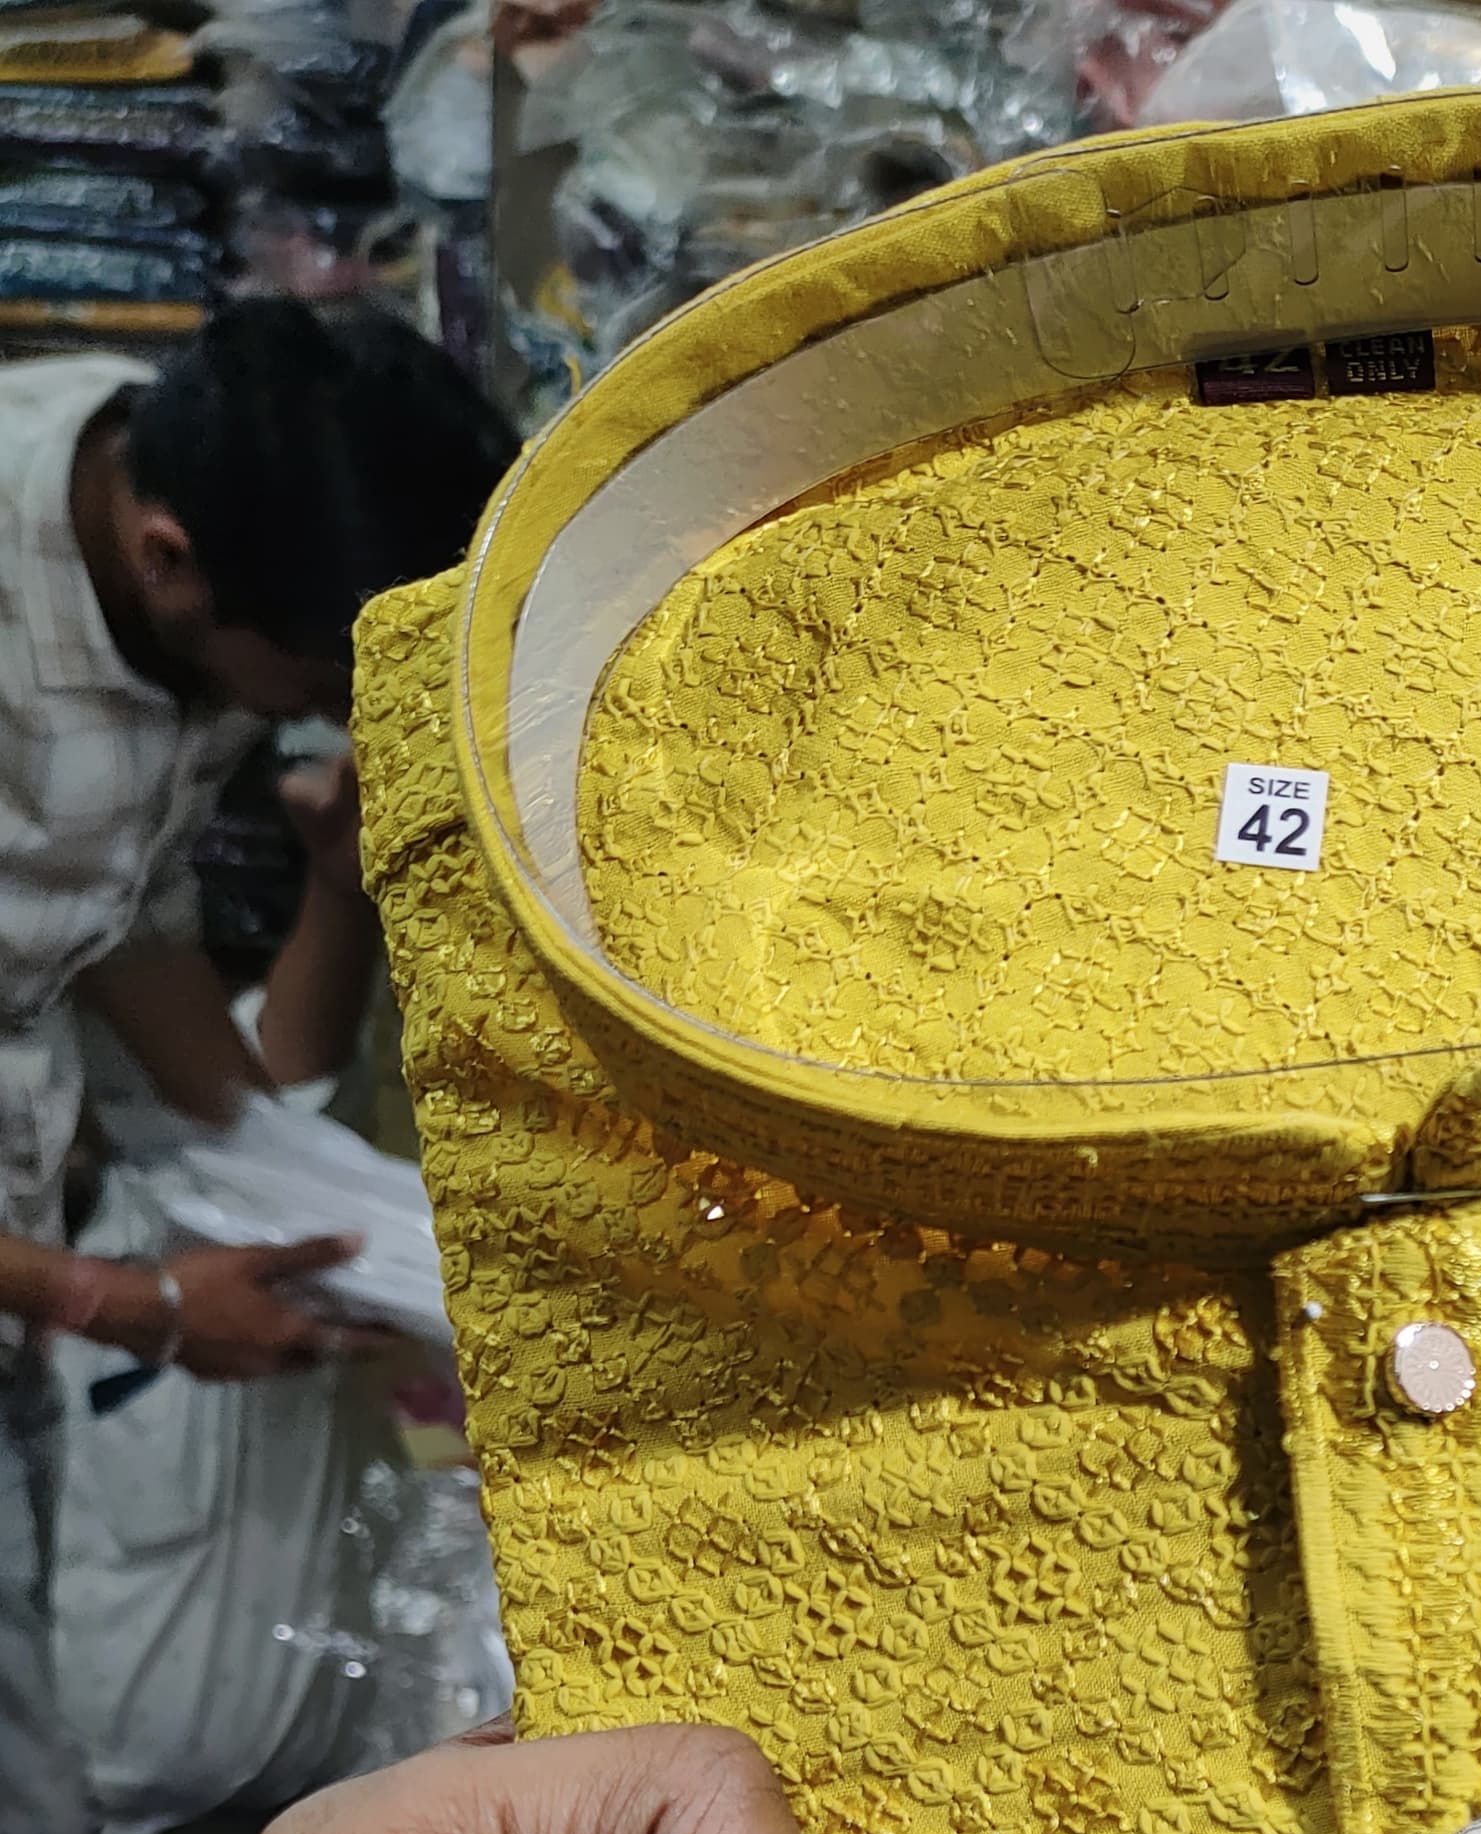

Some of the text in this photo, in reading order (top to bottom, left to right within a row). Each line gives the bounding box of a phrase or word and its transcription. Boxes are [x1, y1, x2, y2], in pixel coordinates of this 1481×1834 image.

[1340, 335, 1425, 358] CLEAN
[1345, 357, 1421, 383] ONLY
[1248, 777, 1311, 800] SIZE
[1237, 803, 1310, 856] 42
